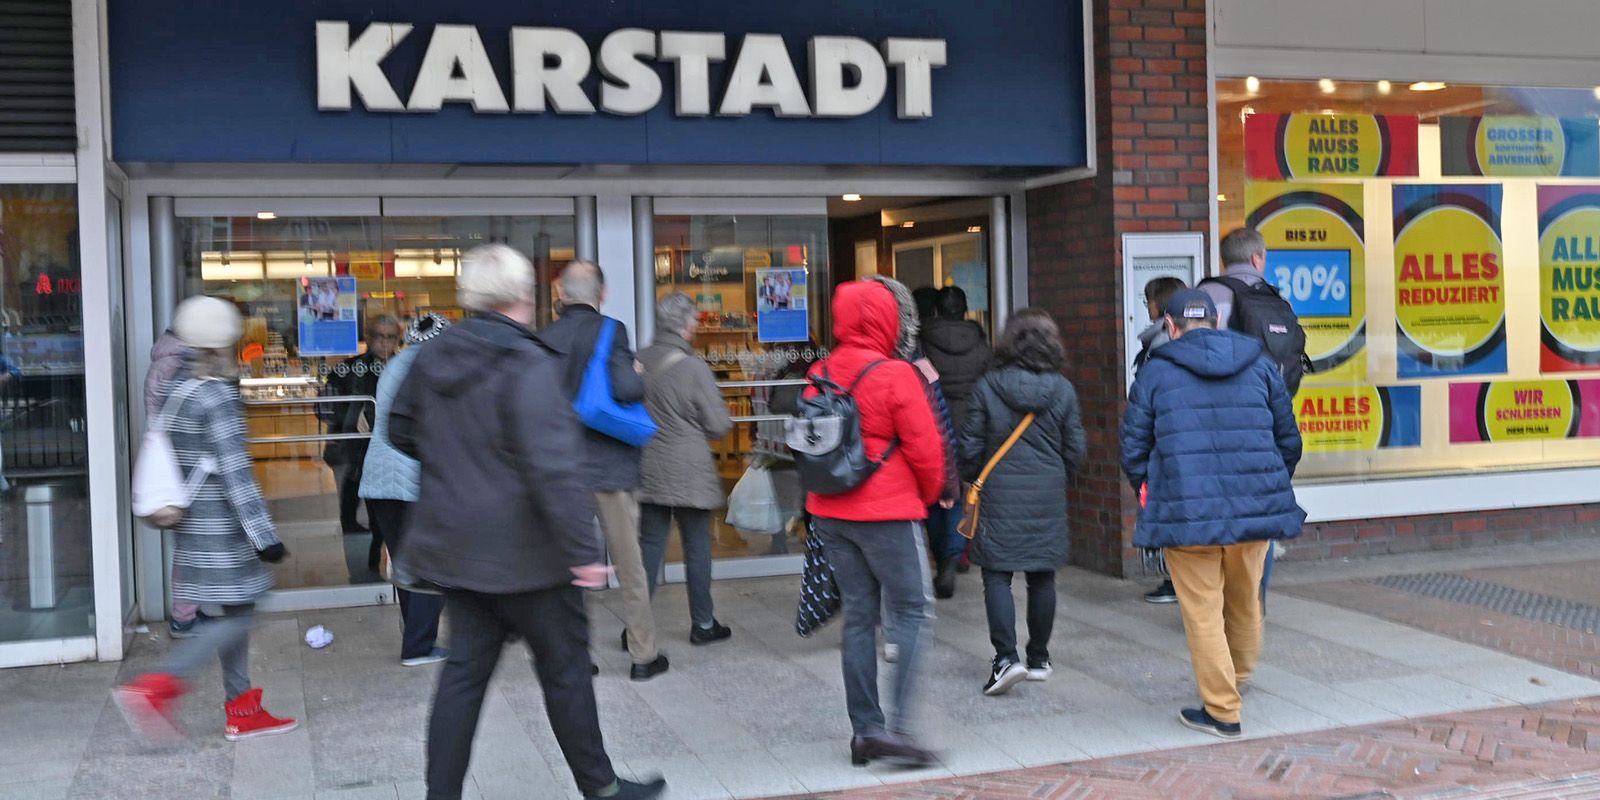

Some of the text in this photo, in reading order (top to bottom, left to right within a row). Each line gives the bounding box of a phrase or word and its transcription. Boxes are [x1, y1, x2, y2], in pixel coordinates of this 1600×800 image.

[315, 19, 948, 120] KARSTADT
[1309, 118, 1359, 135] ALLES
[1486, 128, 1553, 142] GROSSER
[1308, 138, 1359, 154] MUSS
[1307, 156, 1360, 174] RAUS
[1488, 154, 1554, 166] ABVERKAUF
[1285, 230, 1327, 241] BIS ZU
[1551, 236, 1600, 262] ALL
[1398, 252, 1499, 283] ALLES
[1274, 264, 1346, 302] 30%
[1398, 286, 1500, 306] REDUZIERT
[1514, 389, 1544, 406] WIR
[1301, 396, 1371, 417] ALLES
[1496, 407, 1562, 421] SCHLIESSEN
[1300, 419, 1371, 434] REDUZIERT
